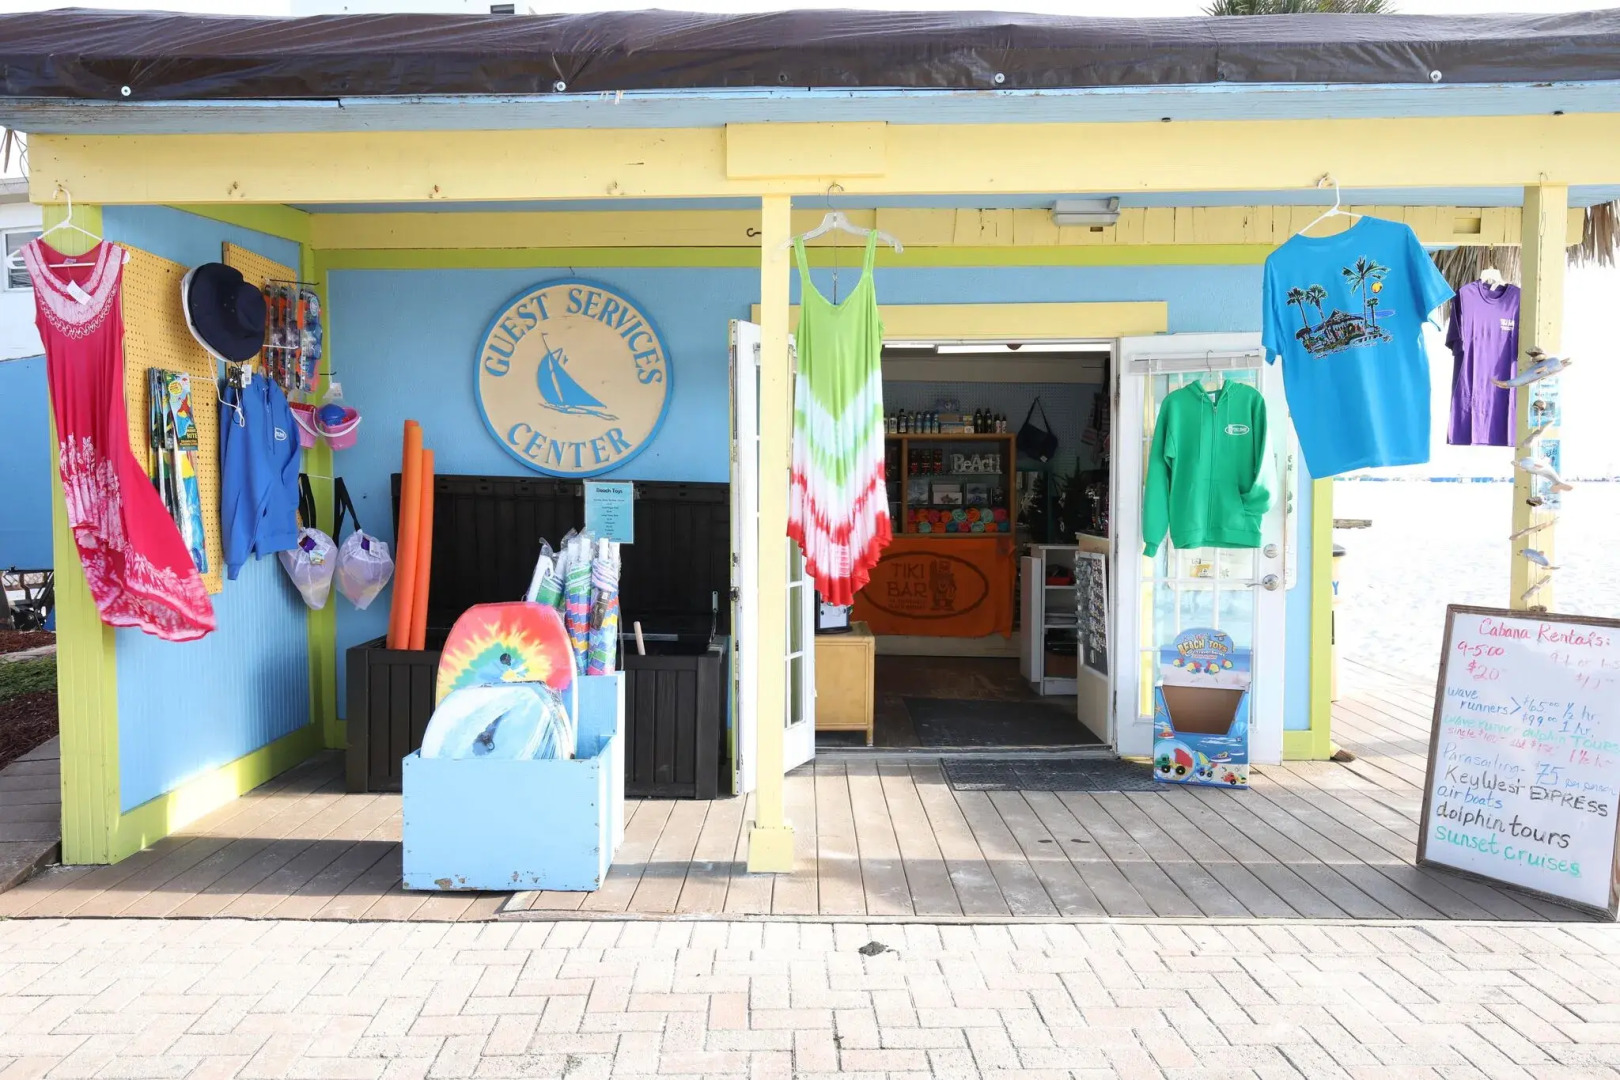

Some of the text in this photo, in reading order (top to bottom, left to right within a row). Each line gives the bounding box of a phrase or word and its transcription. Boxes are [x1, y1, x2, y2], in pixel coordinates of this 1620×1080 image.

[484, 288, 663, 385] GUEST SERVICES
[507, 422, 632, 468] CENTER
[891, 563, 925, 579] TIKI
[887, 581, 928, 598] BAR
[1479, 618, 1531, 639] Cabana
[1178, 639, 1204, 655] BEACH
[1209, 640, 1228, 652] TOYS
[1447, 686, 1479, 700] wave
[1460, 700, 1508, 715] runners
[1530, 785, 1609, 817] EXPRESS
[1436, 801, 1572, 849] dolphin tours
